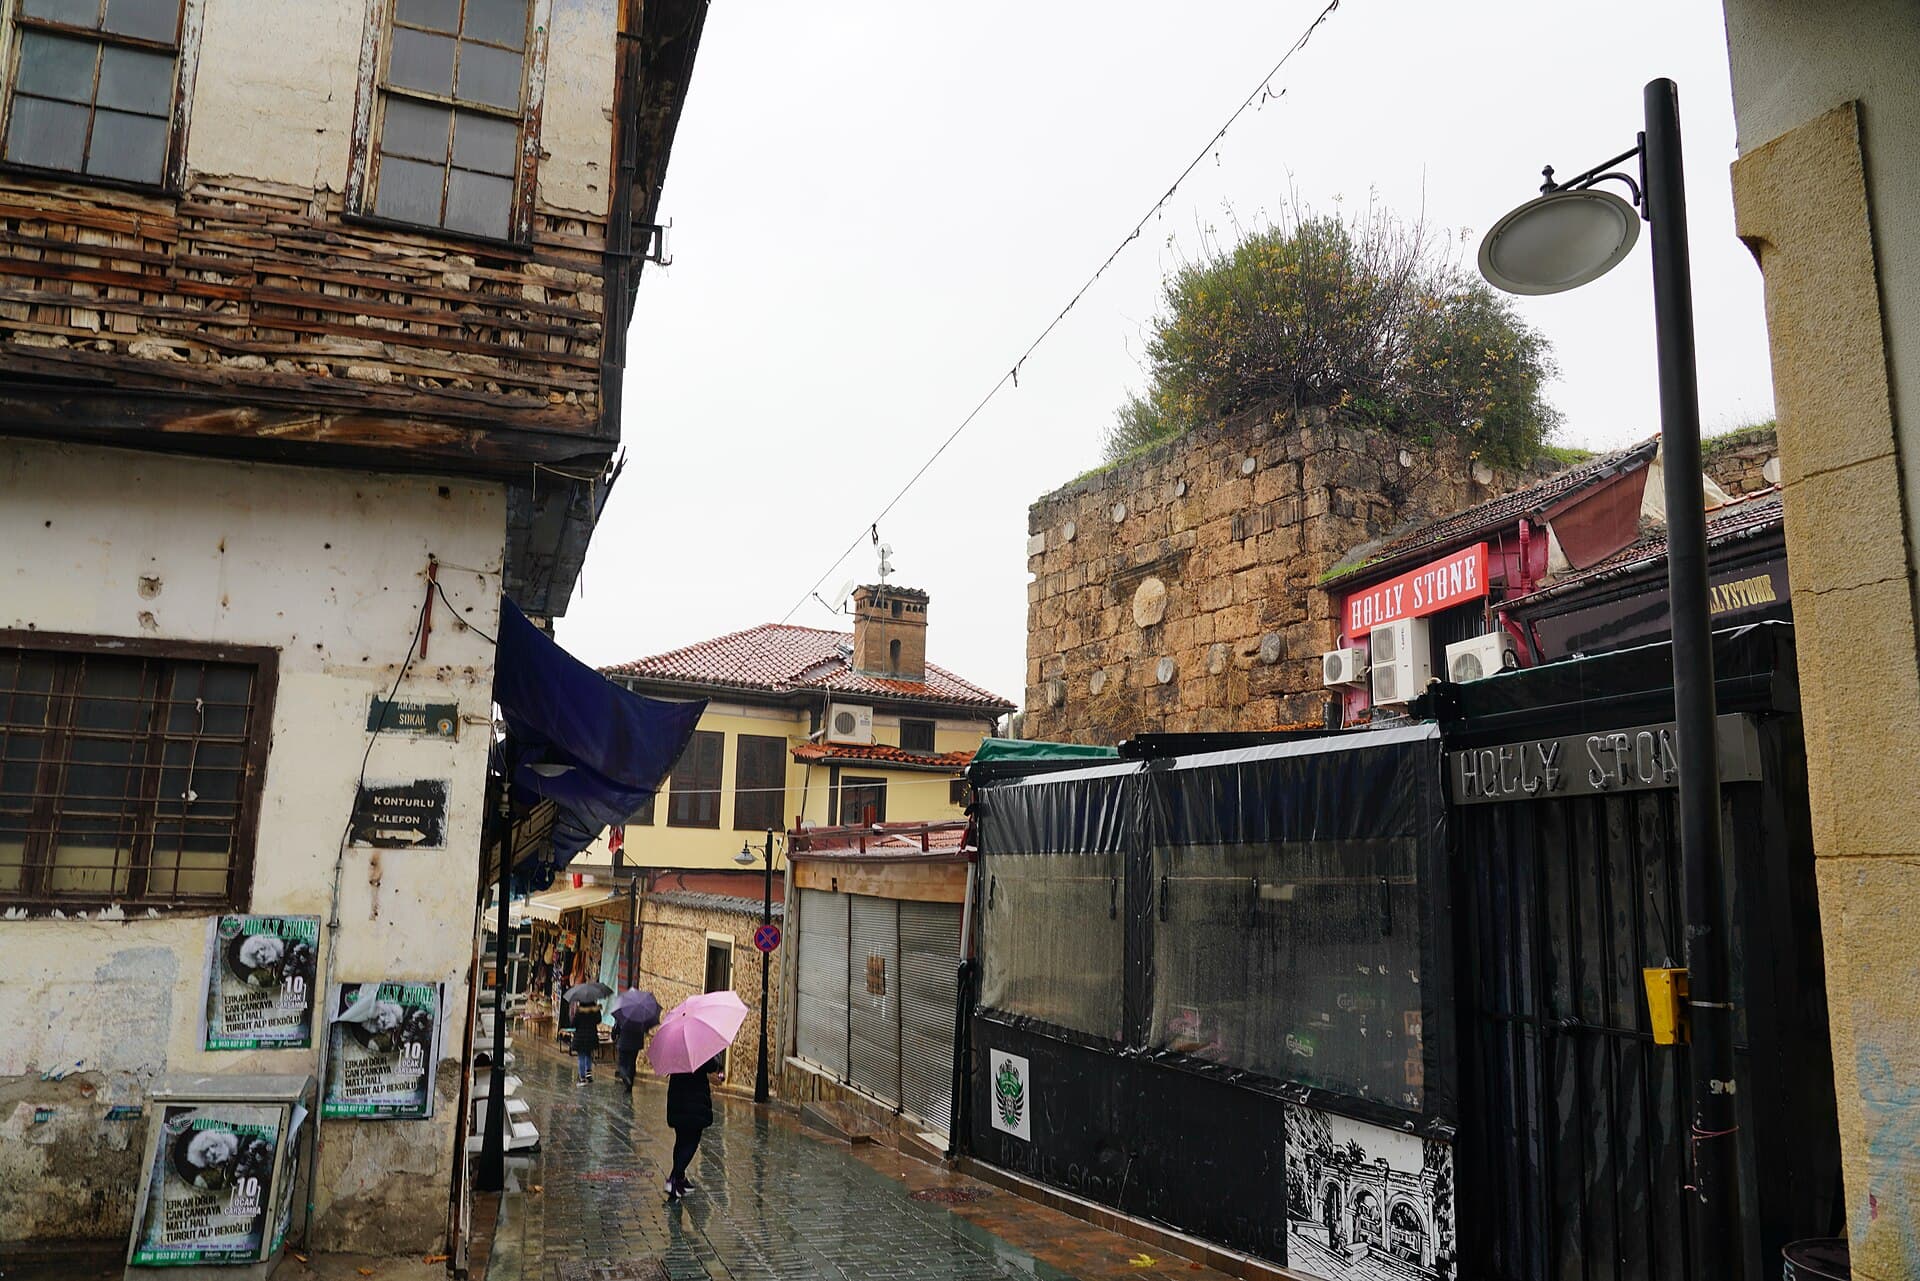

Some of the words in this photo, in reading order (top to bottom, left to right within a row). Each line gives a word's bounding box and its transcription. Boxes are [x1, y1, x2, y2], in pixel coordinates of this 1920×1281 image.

[1351, 583, 1404, 631] HOLLY
[1413, 555, 1477, 609] STONE
[398, 713, 426, 727] SOKAK
[1460, 741, 1560, 798] HOLLY
[1586, 729, 1680, 789] STON
[373, 796, 435, 808] KONTURLU
[283, 920, 316, 937] STONE
[285, 976, 303, 993] 10
[403, 986, 435, 1003] STONE
[225, 1003, 240, 1013] CAN
[225, 1013, 244, 1022] MATT
[403, 1042, 421, 1059] 10
[345, 1069, 360, 1078] CAN
[237, 1177, 258, 1197] 10
[234, 1197, 255, 1207] OCAK
[166, 1209, 182, 1221] CAN
[166, 1220, 187, 1231] MATT
[166, 1231, 196, 1243] TURGUT
[198, 1228, 214, 1239] ALP
